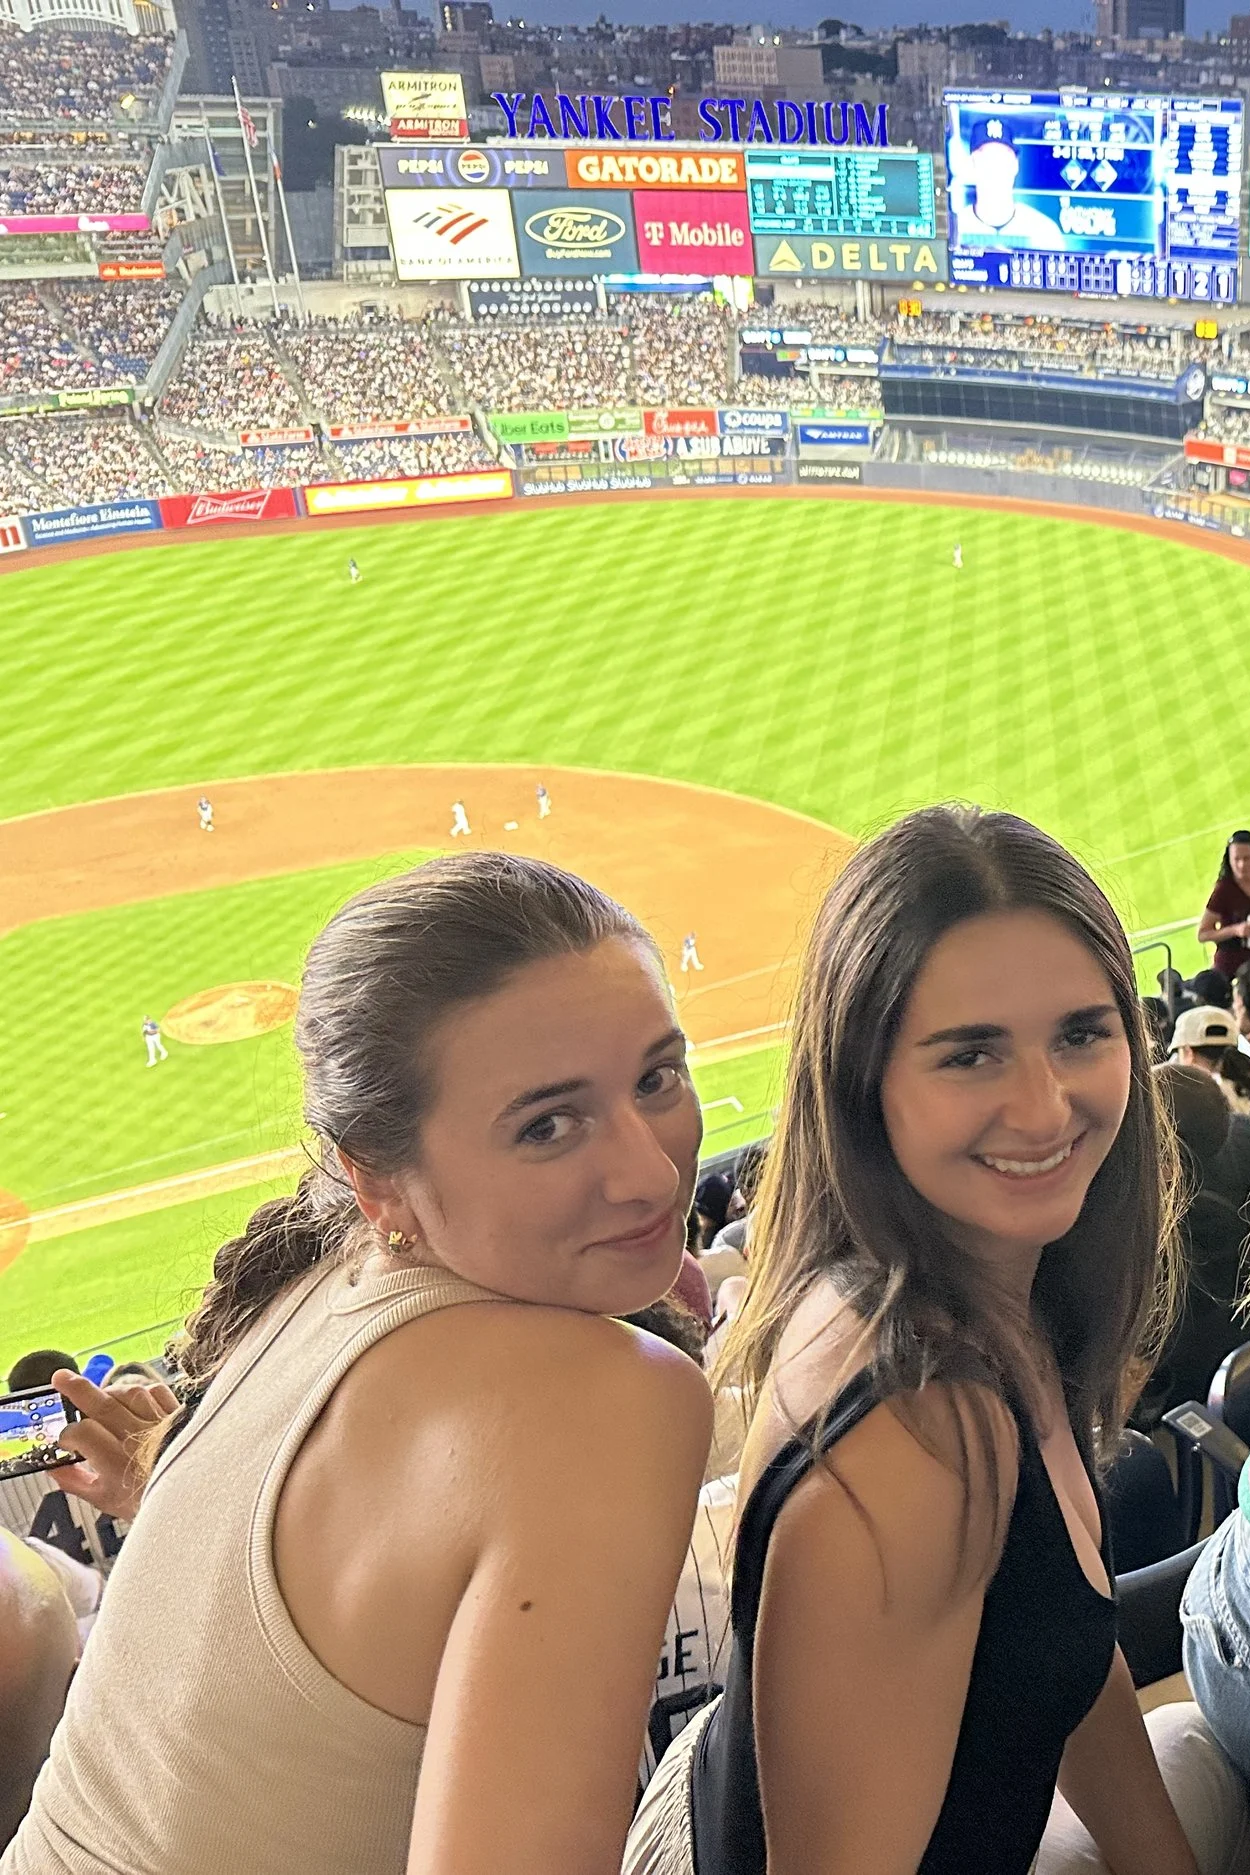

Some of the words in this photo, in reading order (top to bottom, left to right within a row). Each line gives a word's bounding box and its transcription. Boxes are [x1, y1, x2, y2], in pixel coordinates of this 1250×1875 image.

[388, 80, 457, 92] ARMITRON
[397, 118, 460, 131] ARMITRON
[490, 92, 675, 142] YANKEE
[698, 98, 890, 147] STADIUM
[578, 155, 738, 186] GATORADE
[543, 212, 609, 242] Ford
[669, 221, 745, 248] Mobile
[811, 242, 938, 273] DELTA
[723, 436, 770, 456] ABOVE
[196, 499, 263, 517] Budweiser
[32, 513, 99, 532] Montefiore
